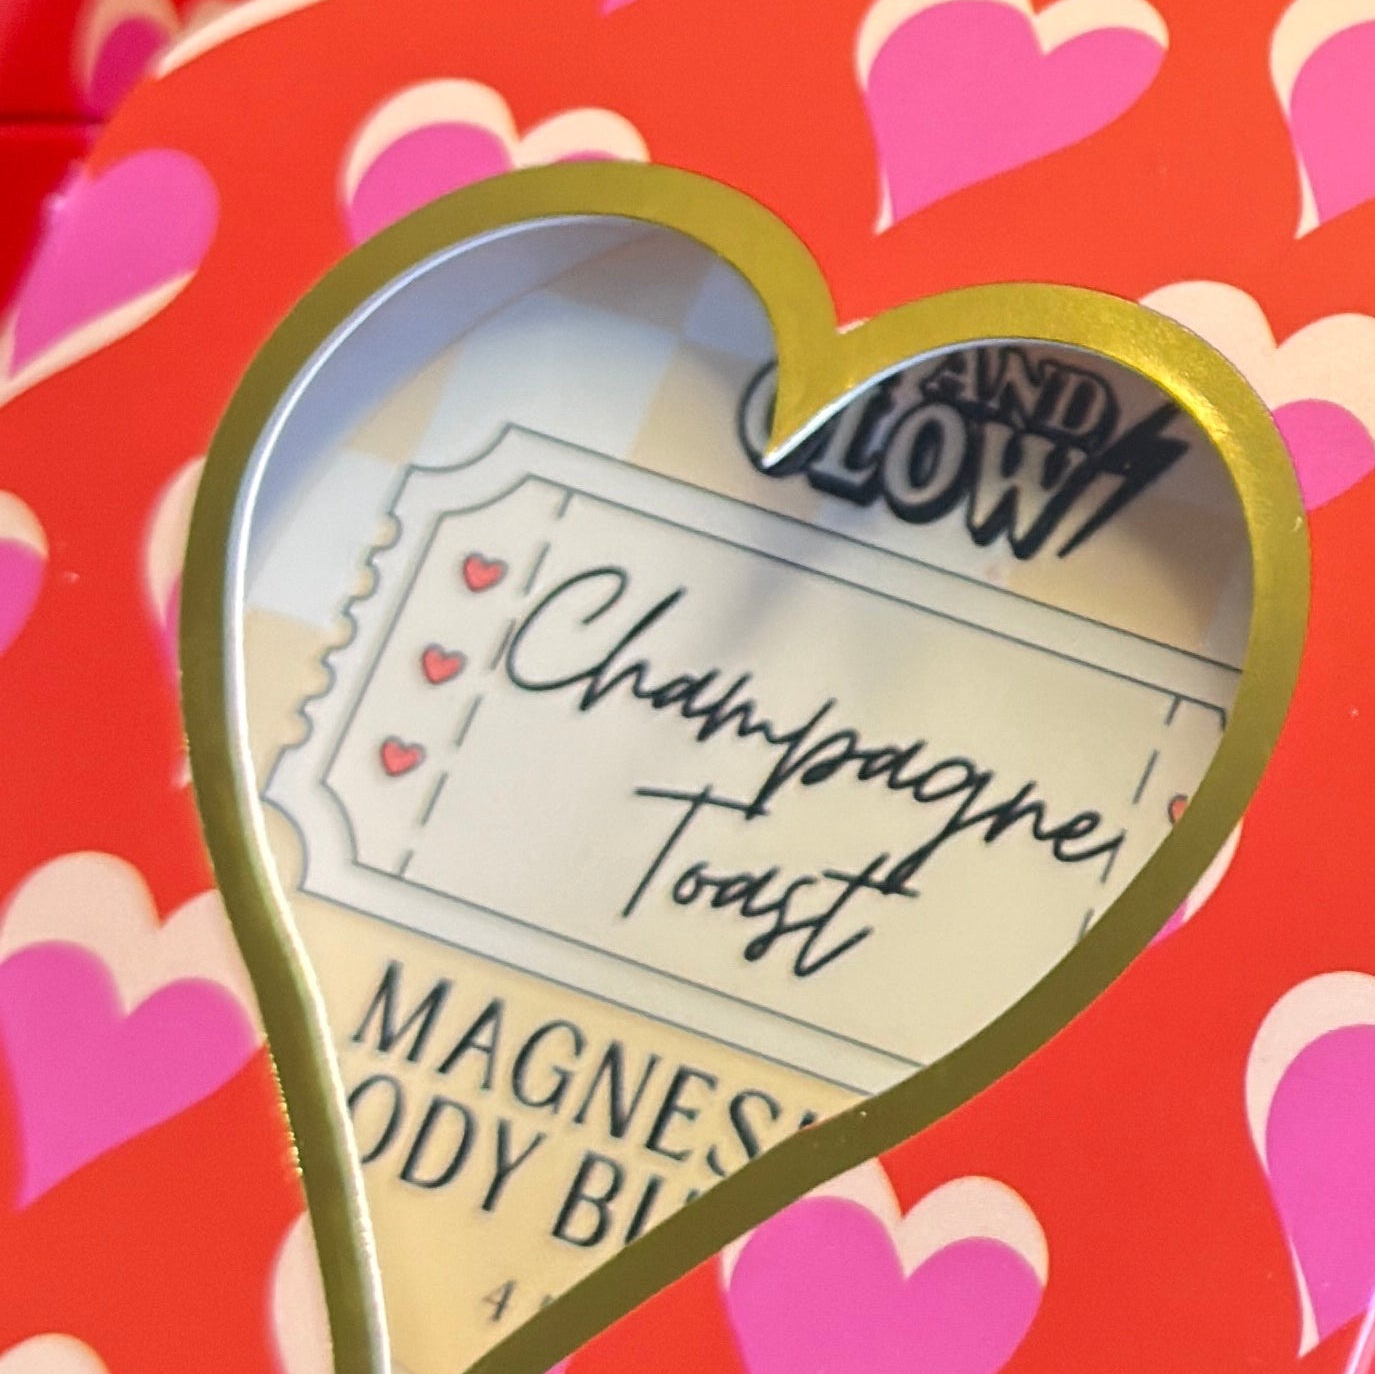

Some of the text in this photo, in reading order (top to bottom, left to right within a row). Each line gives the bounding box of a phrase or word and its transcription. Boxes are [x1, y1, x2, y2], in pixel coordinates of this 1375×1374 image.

[504, 564, 1125, 895] Champagne
[622, 783, 920, 978] Toast
[352, 959, 817, 1179] MAGNES
